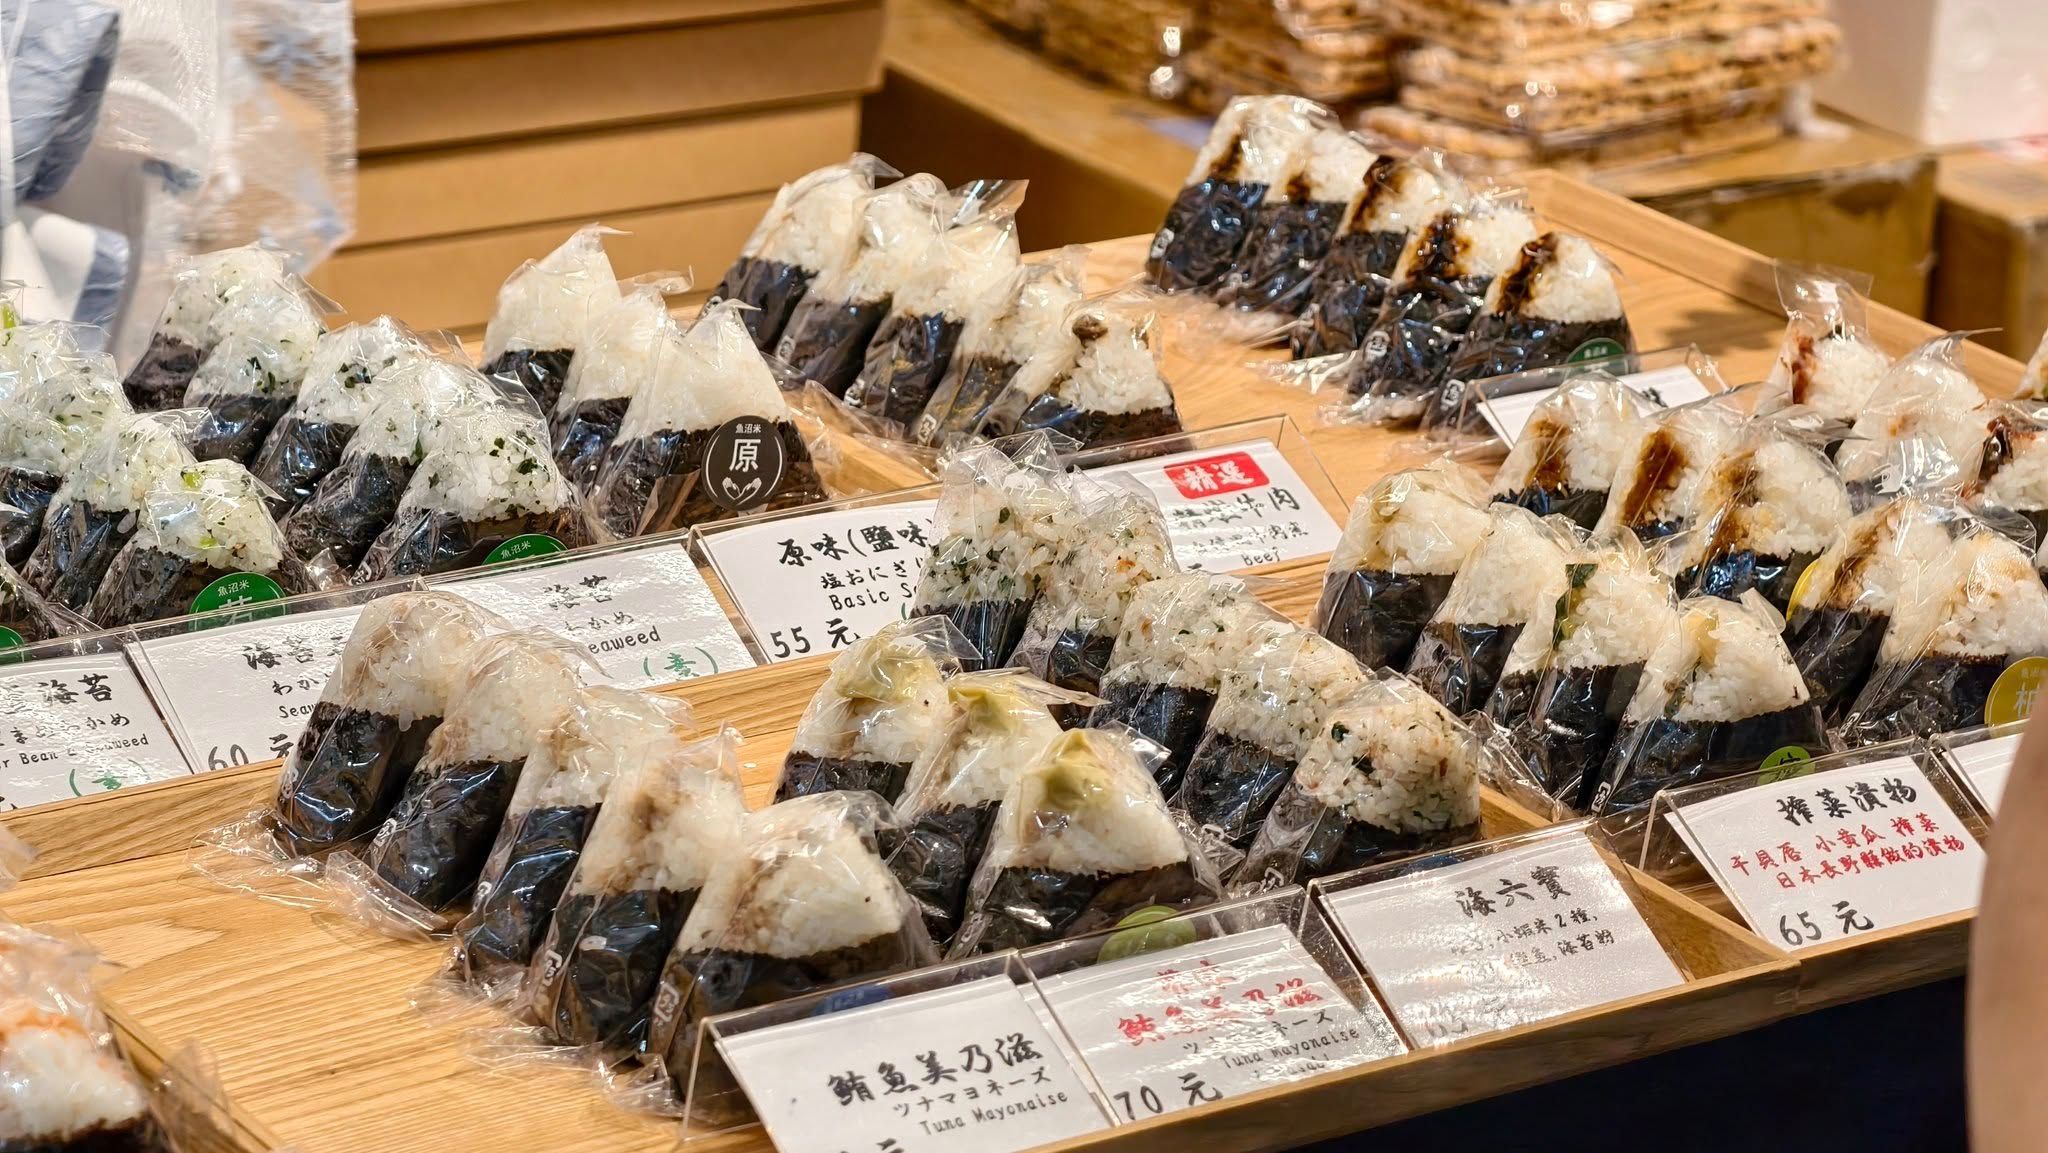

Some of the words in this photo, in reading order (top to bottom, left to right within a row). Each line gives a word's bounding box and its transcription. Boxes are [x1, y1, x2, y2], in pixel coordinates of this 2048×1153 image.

[729, 438, 761, 472] 原
[1183, 460, 1254, 492] 精選
[777, 518, 933, 567] 原味(鹽味
[216, 579, 251, 598] 魚沼米
[829, 589, 890, 611] Basic
[900, 582, 917, 598] S
[588, 625, 661, 655] eaweed
[770, 626, 811, 658] 55
[825, 618, 861, 649] 元
[272, 671, 332, 697] わか
[1779, 910, 1822, 947] 65
[1831, 900, 1875, 935] 元
[827, 1032, 1043, 1107] 鮪魚美乃滋
[892, 1066, 1052, 1118] ツナマヨネーズ
[1114, 1085, 1164, 1121] 70
[1177, 1072, 1224, 1106] 元
[919, 1115, 967, 1136] Tuna
[971, 1089, 1069, 1123] Mayonaise
